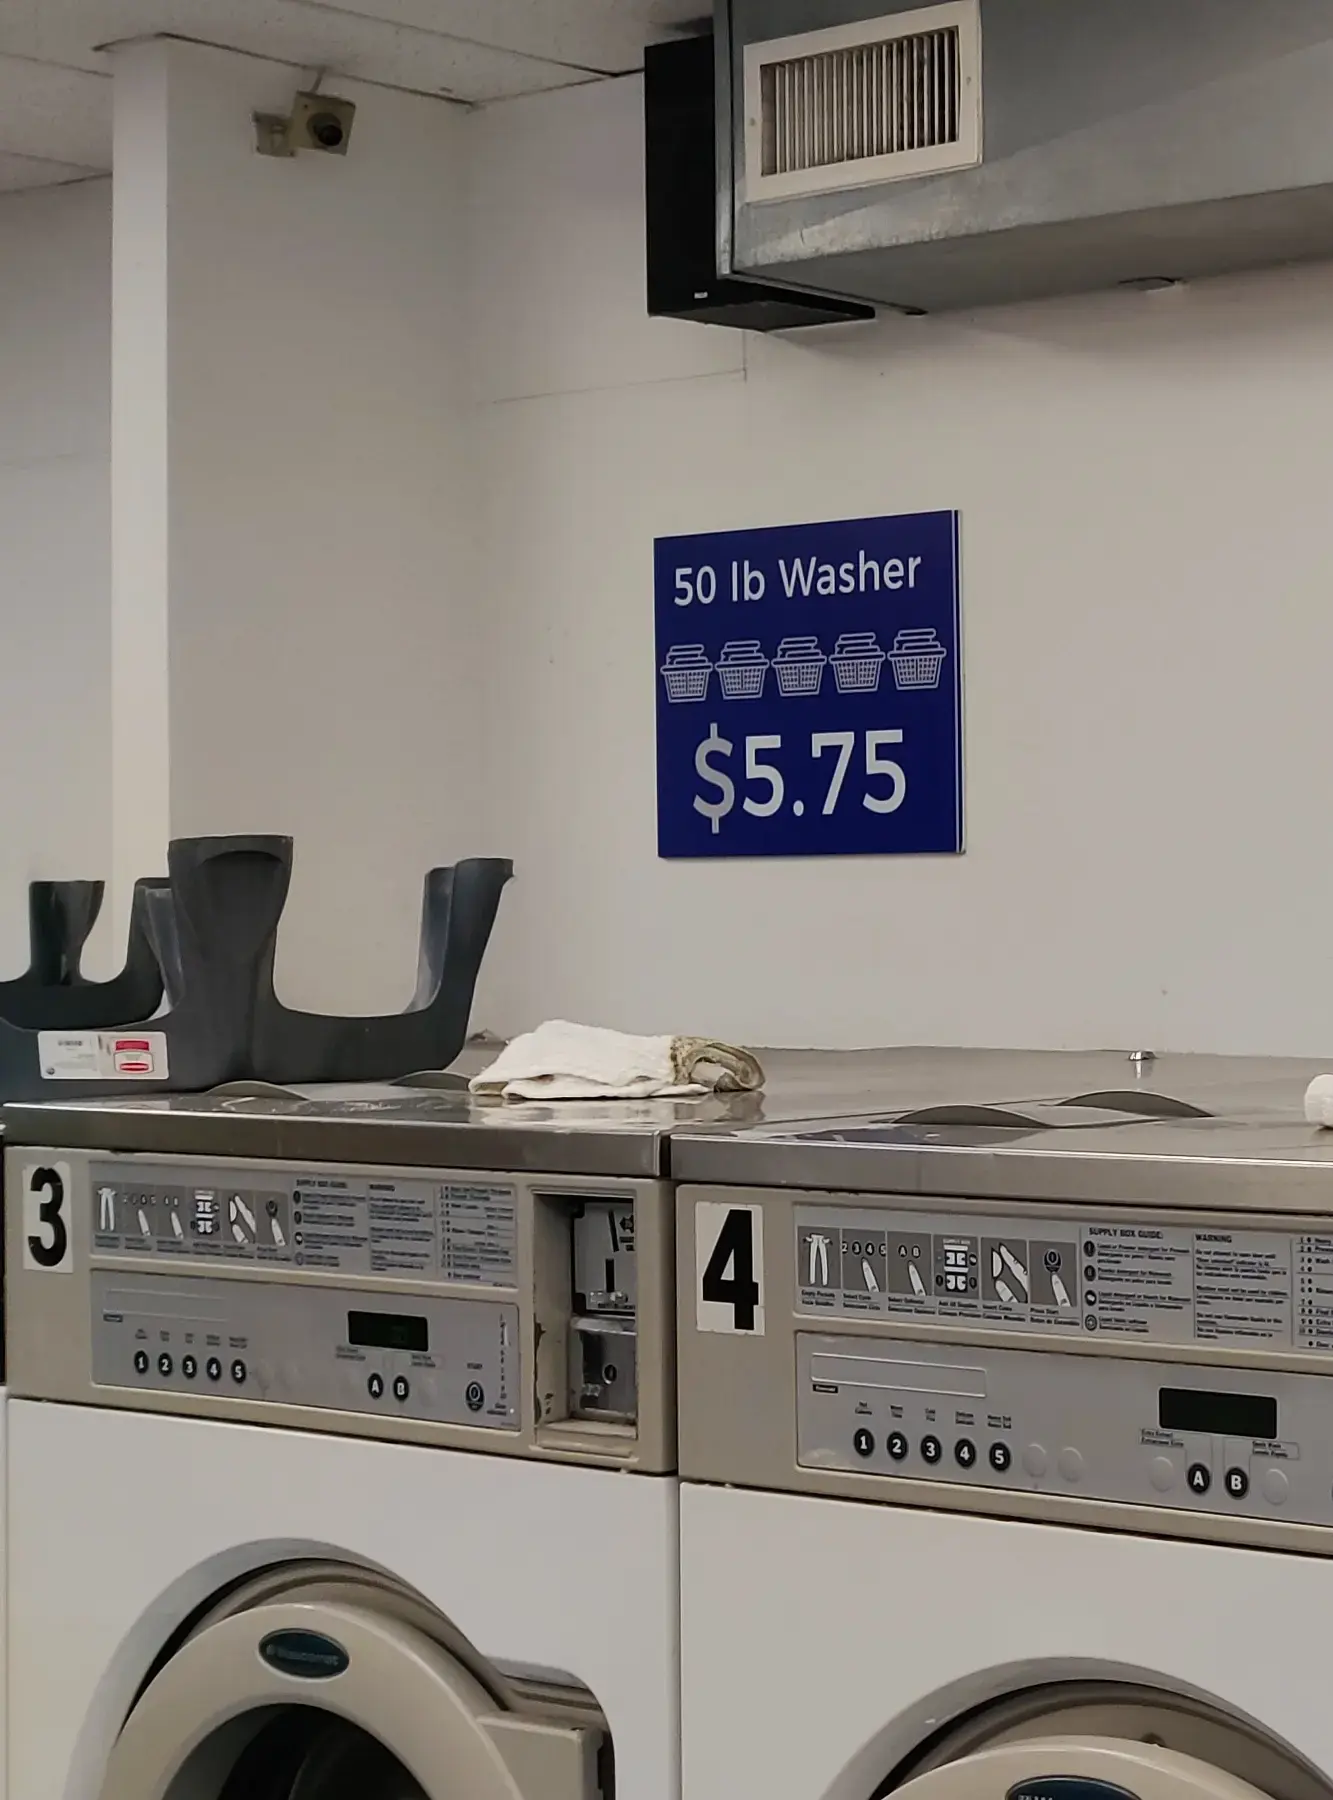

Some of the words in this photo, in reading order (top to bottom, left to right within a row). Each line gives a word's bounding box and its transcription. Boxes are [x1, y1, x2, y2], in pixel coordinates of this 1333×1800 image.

[674, 566, 716, 606] 50
[732, 560, 765, 602] lb
[779, 550, 921, 598] Washer
[693, 723, 906, 834] $5.75
[28, 1167, 66, 1266] 3
[703, 1209, 758, 1329] 4
[139, 1357, 143, 1368] 1
[162, 1359, 168, 1371] 2
[186, 1361, 193, 1373] 3
[210, 1364, 217, 1375] 4
[235, 1366, 242, 1377] 5
[372, 1380, 379, 1393] A
[397, 1382, 404, 1395] B
[860, 1436, 867, 1449] 1
[893, 1439, 901, 1453] 2
[926, 1443, 935, 1456] 3
[960, 1446, 969, 1460] 4
[995, 1450, 1004, 1464] 5
[1194, 1471, 1204, 1487] A
[1231, 1475, 1241, 1491] B
